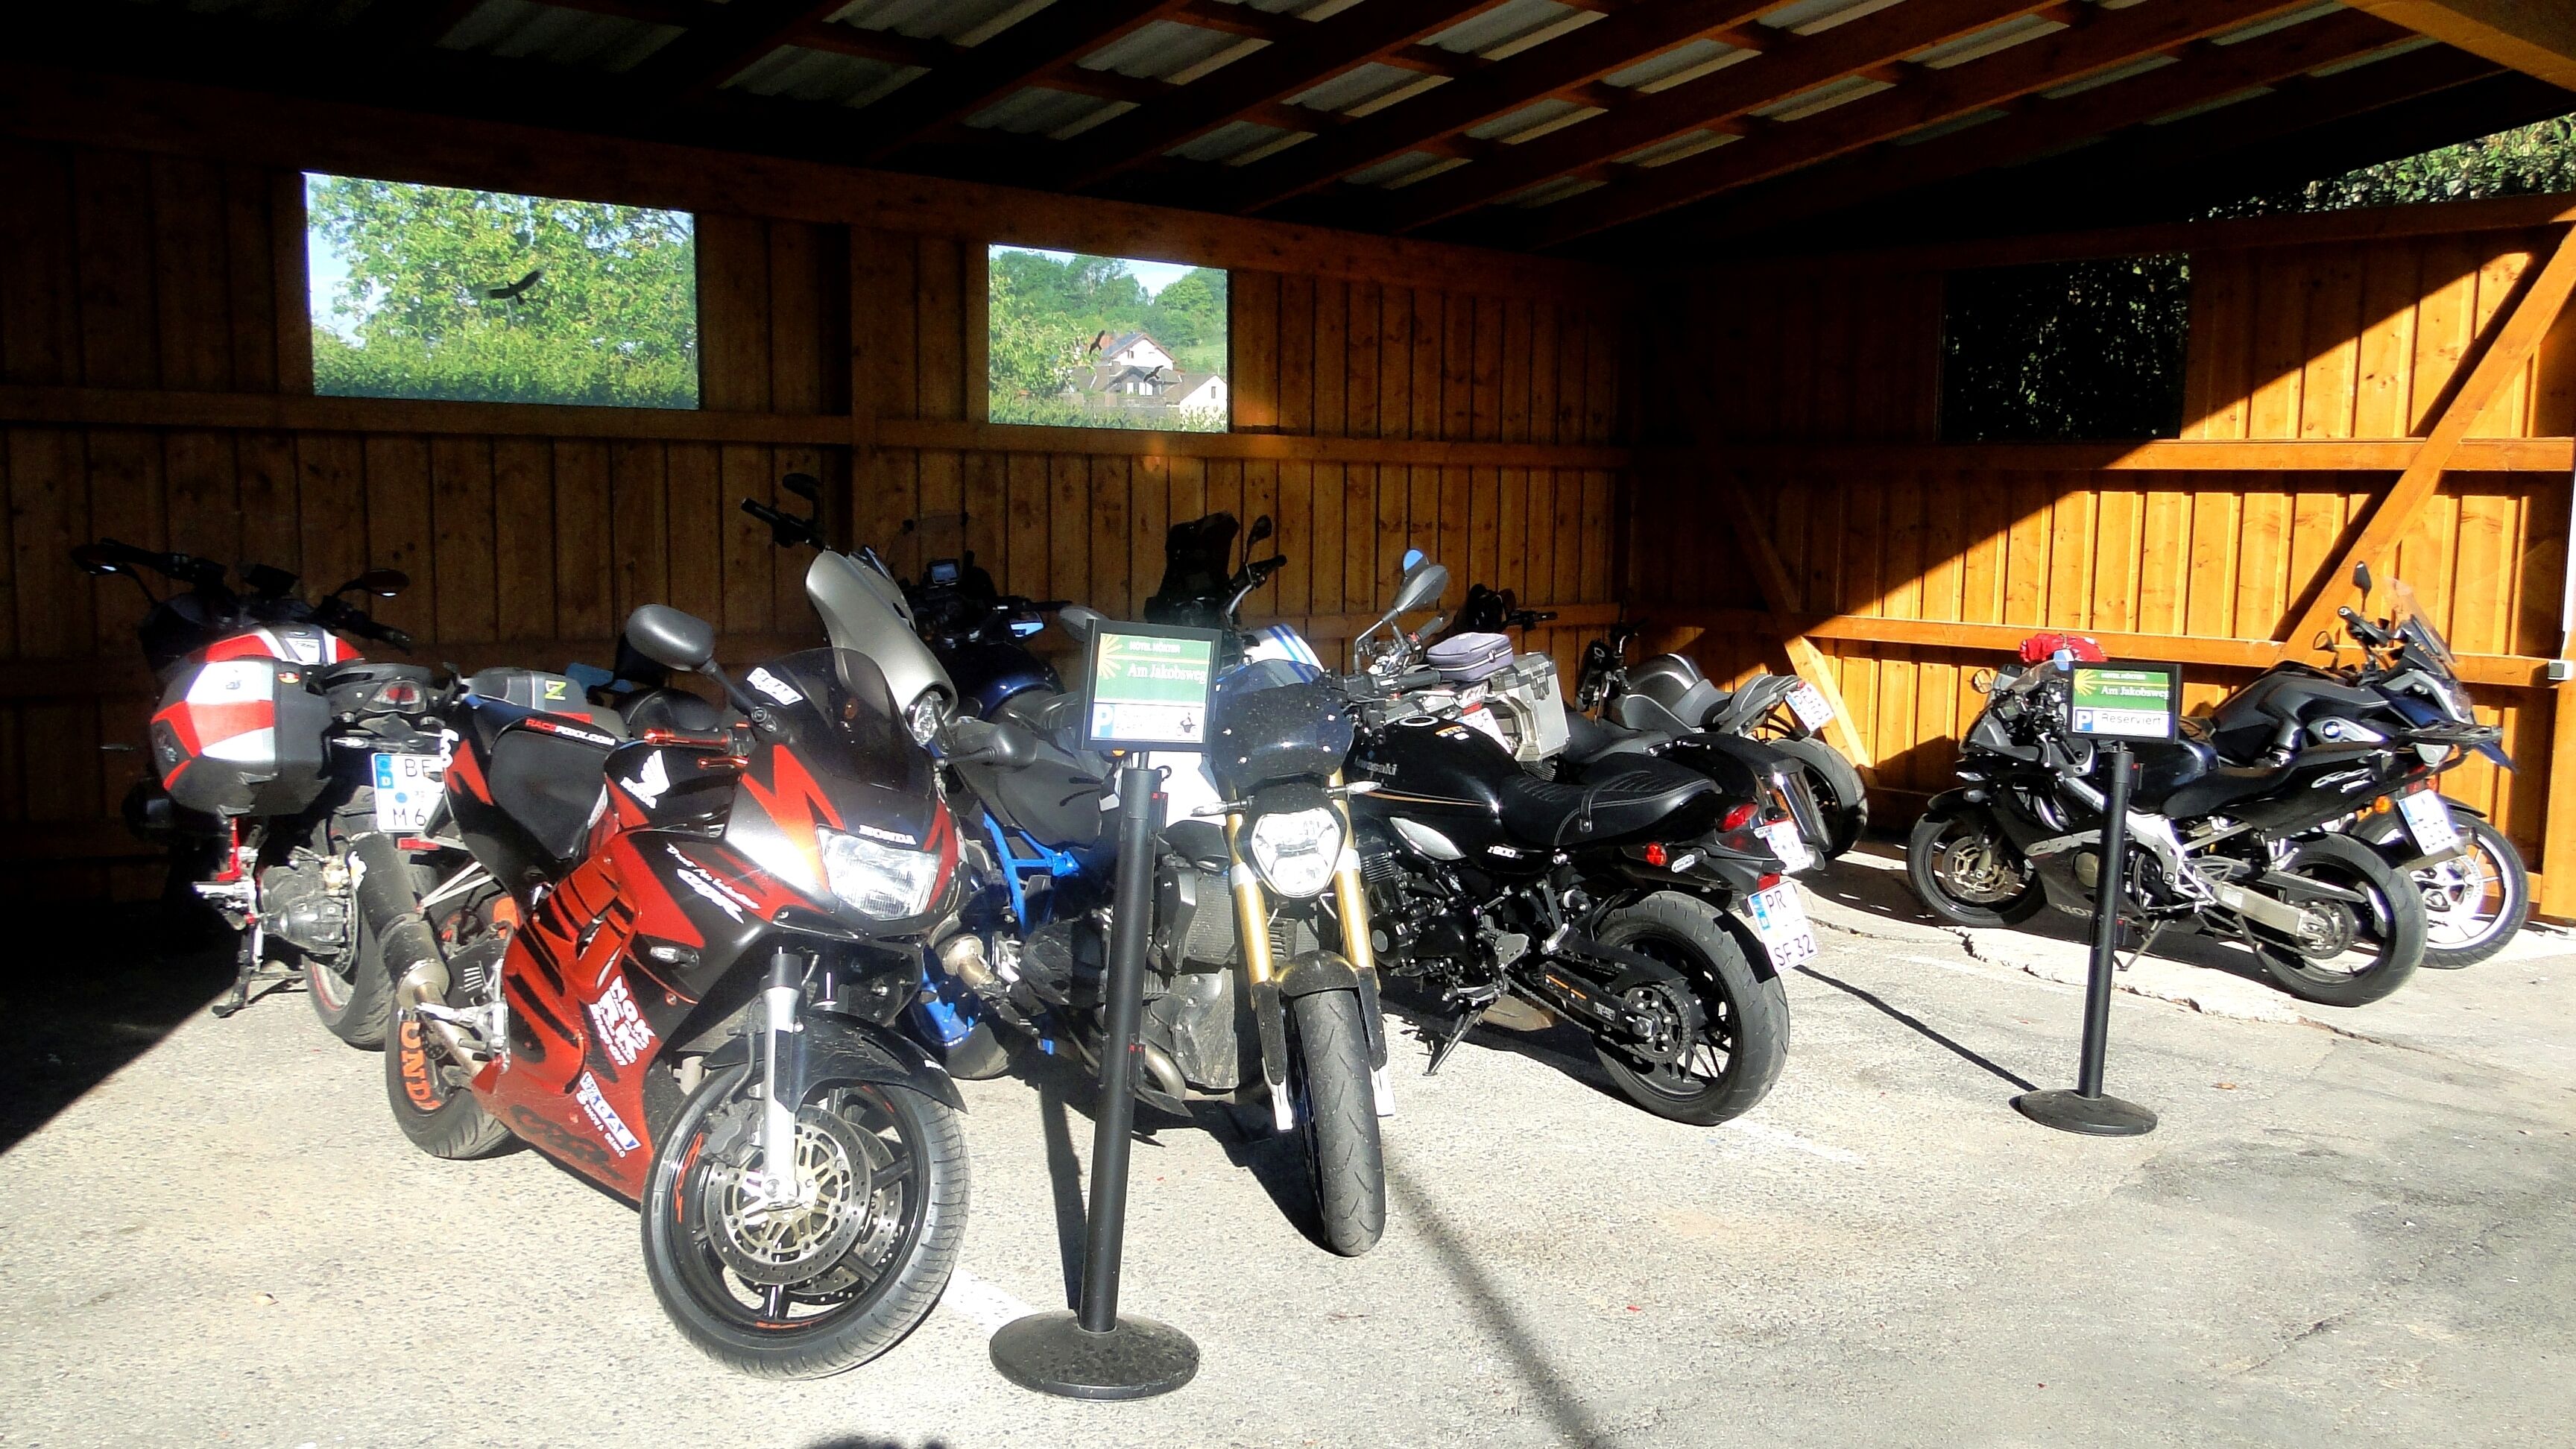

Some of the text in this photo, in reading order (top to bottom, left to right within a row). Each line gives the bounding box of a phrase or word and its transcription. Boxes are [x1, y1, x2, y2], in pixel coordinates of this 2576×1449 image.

[1127, 663, 1206, 685] Am Jakobsweg
[2100, 686, 2169, 700] Am Jakobsweg
[2102, 713, 2162, 726] Reserviert
[619, 777, 657, 809] HONDA
[858, 824, 917, 845] HONDA
